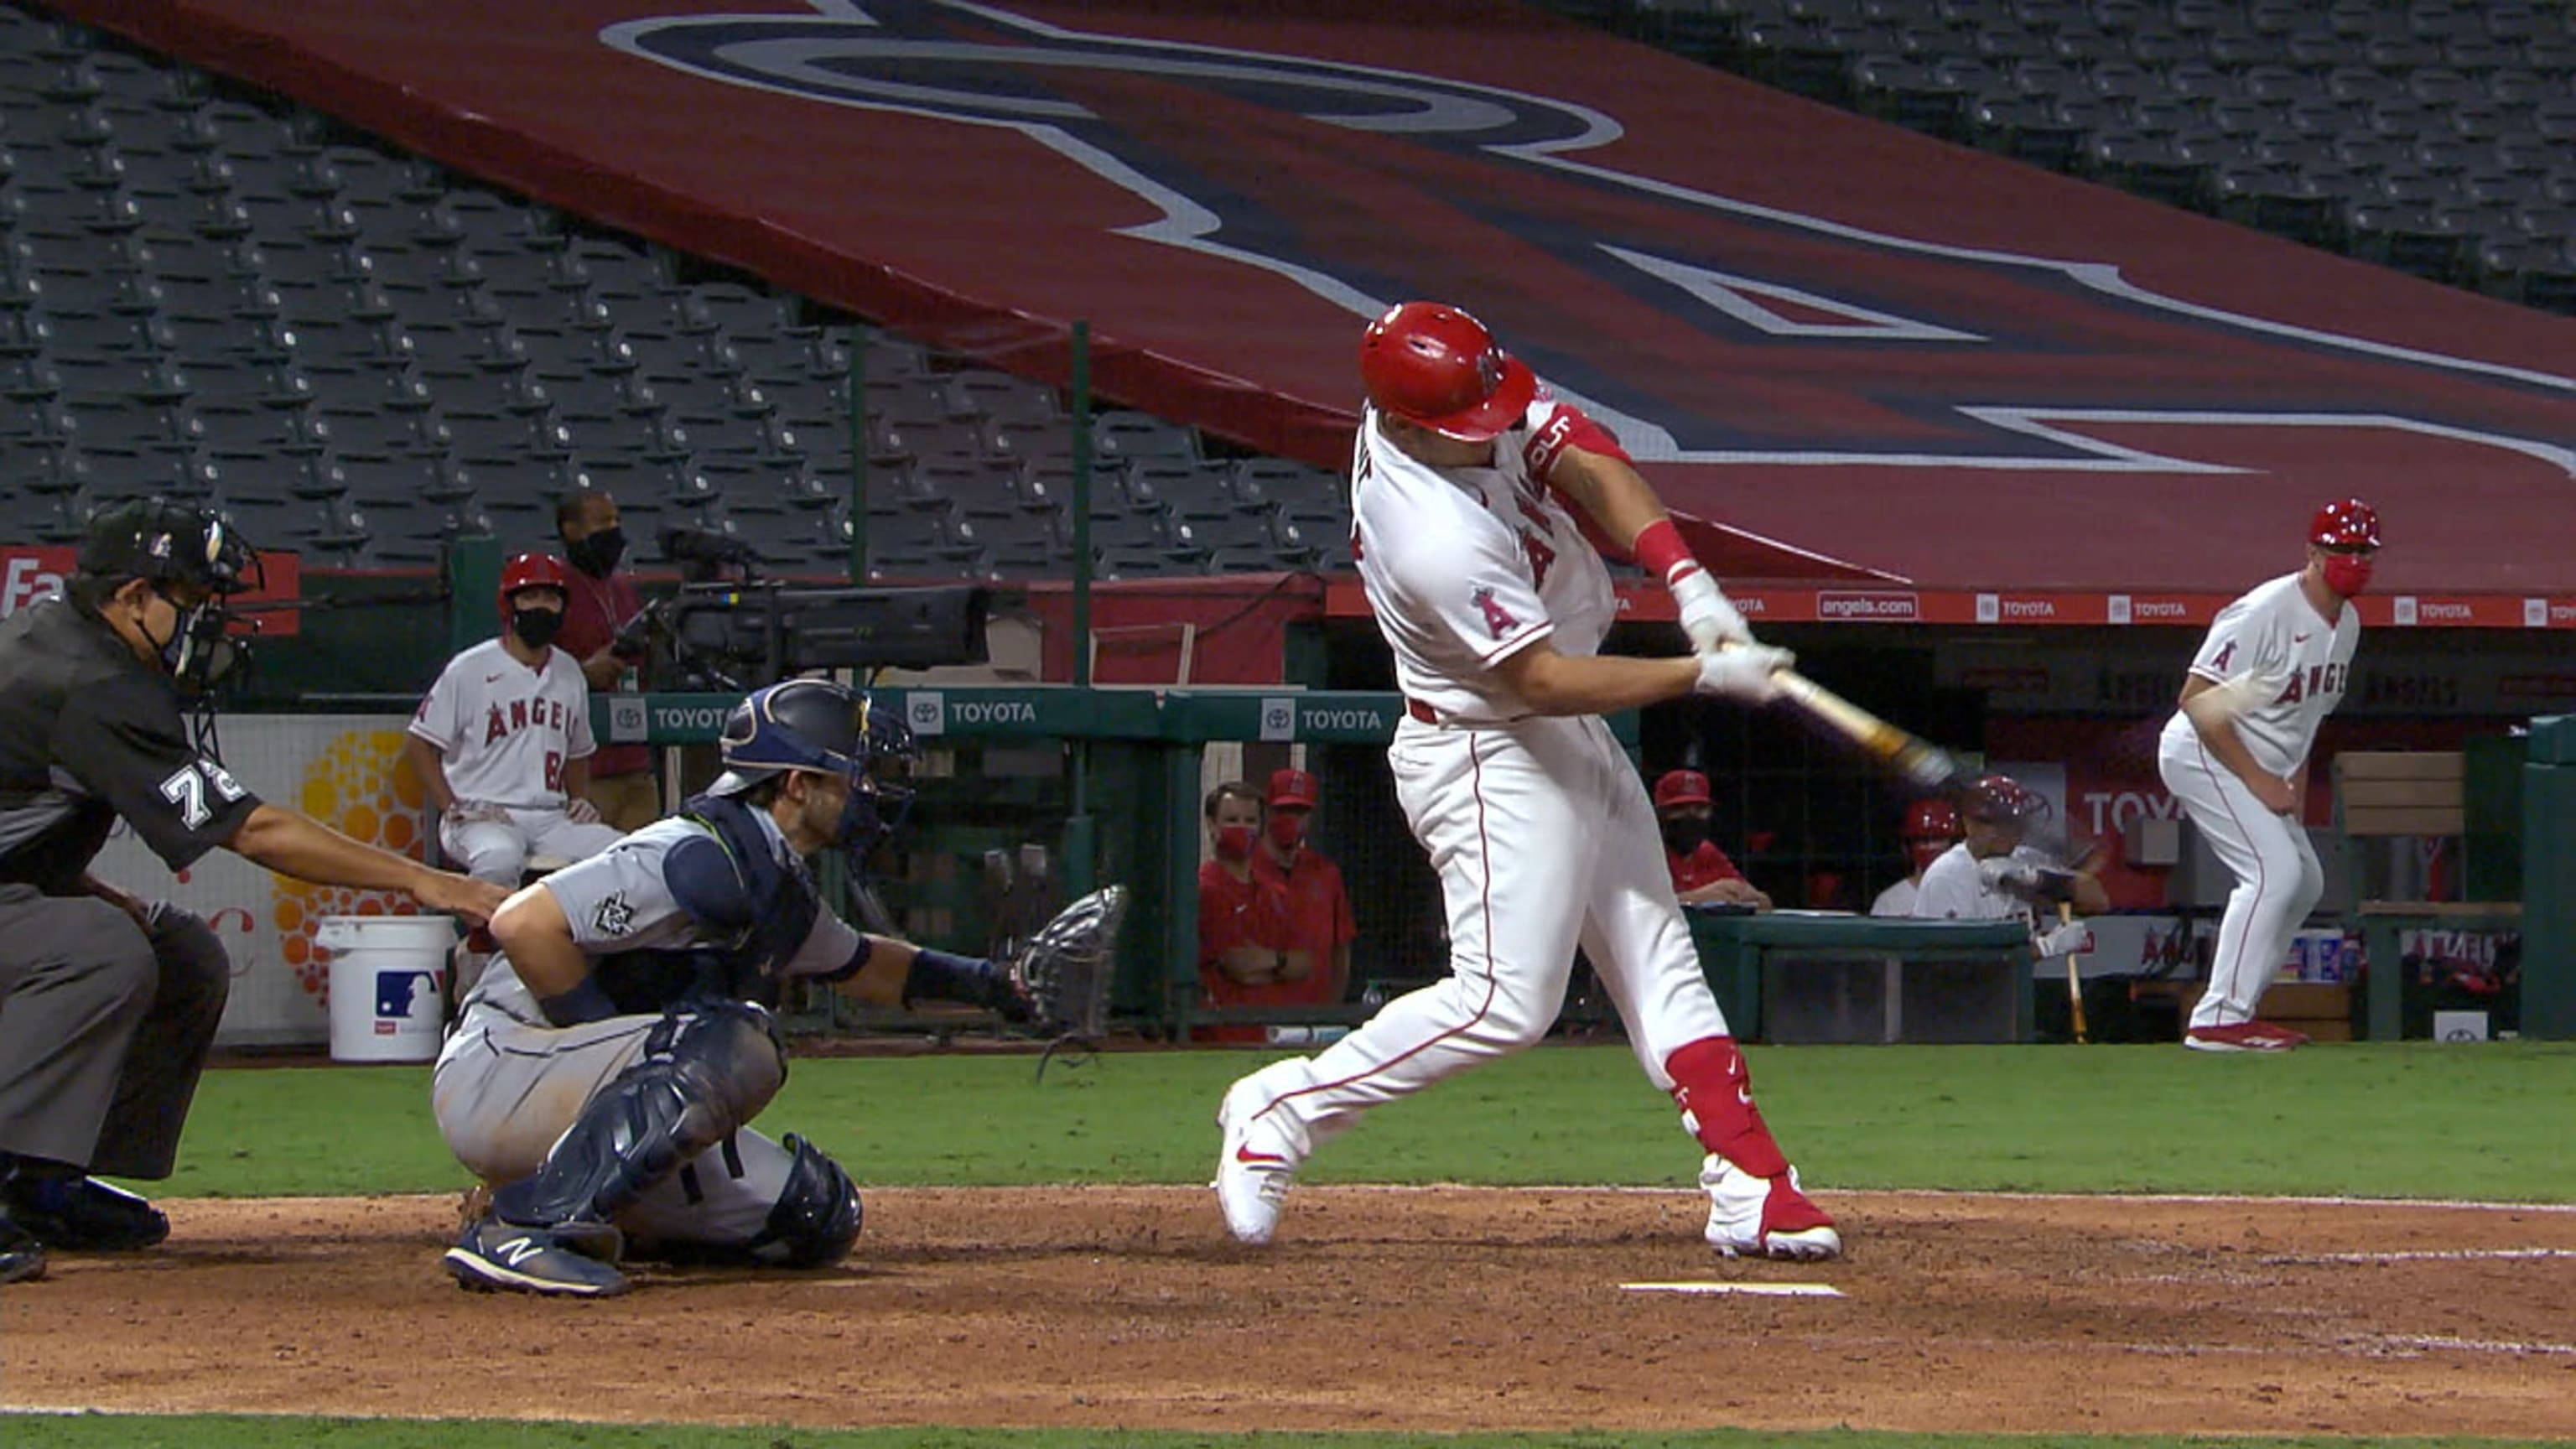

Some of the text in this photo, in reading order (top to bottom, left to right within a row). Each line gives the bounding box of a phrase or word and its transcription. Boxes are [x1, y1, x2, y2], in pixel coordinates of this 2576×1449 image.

[1822, 597, 1913, 616] angels.com
[2003, 601, 2055, 615] TOYOTA
[2135, 603, 2186, 616] TOYOTA
[2420, 604, 2473, 618] TOYOTA
[952, 703, 1036, 723] TOYOTA
[1302, 710, 1382, 730] TOYOTA
